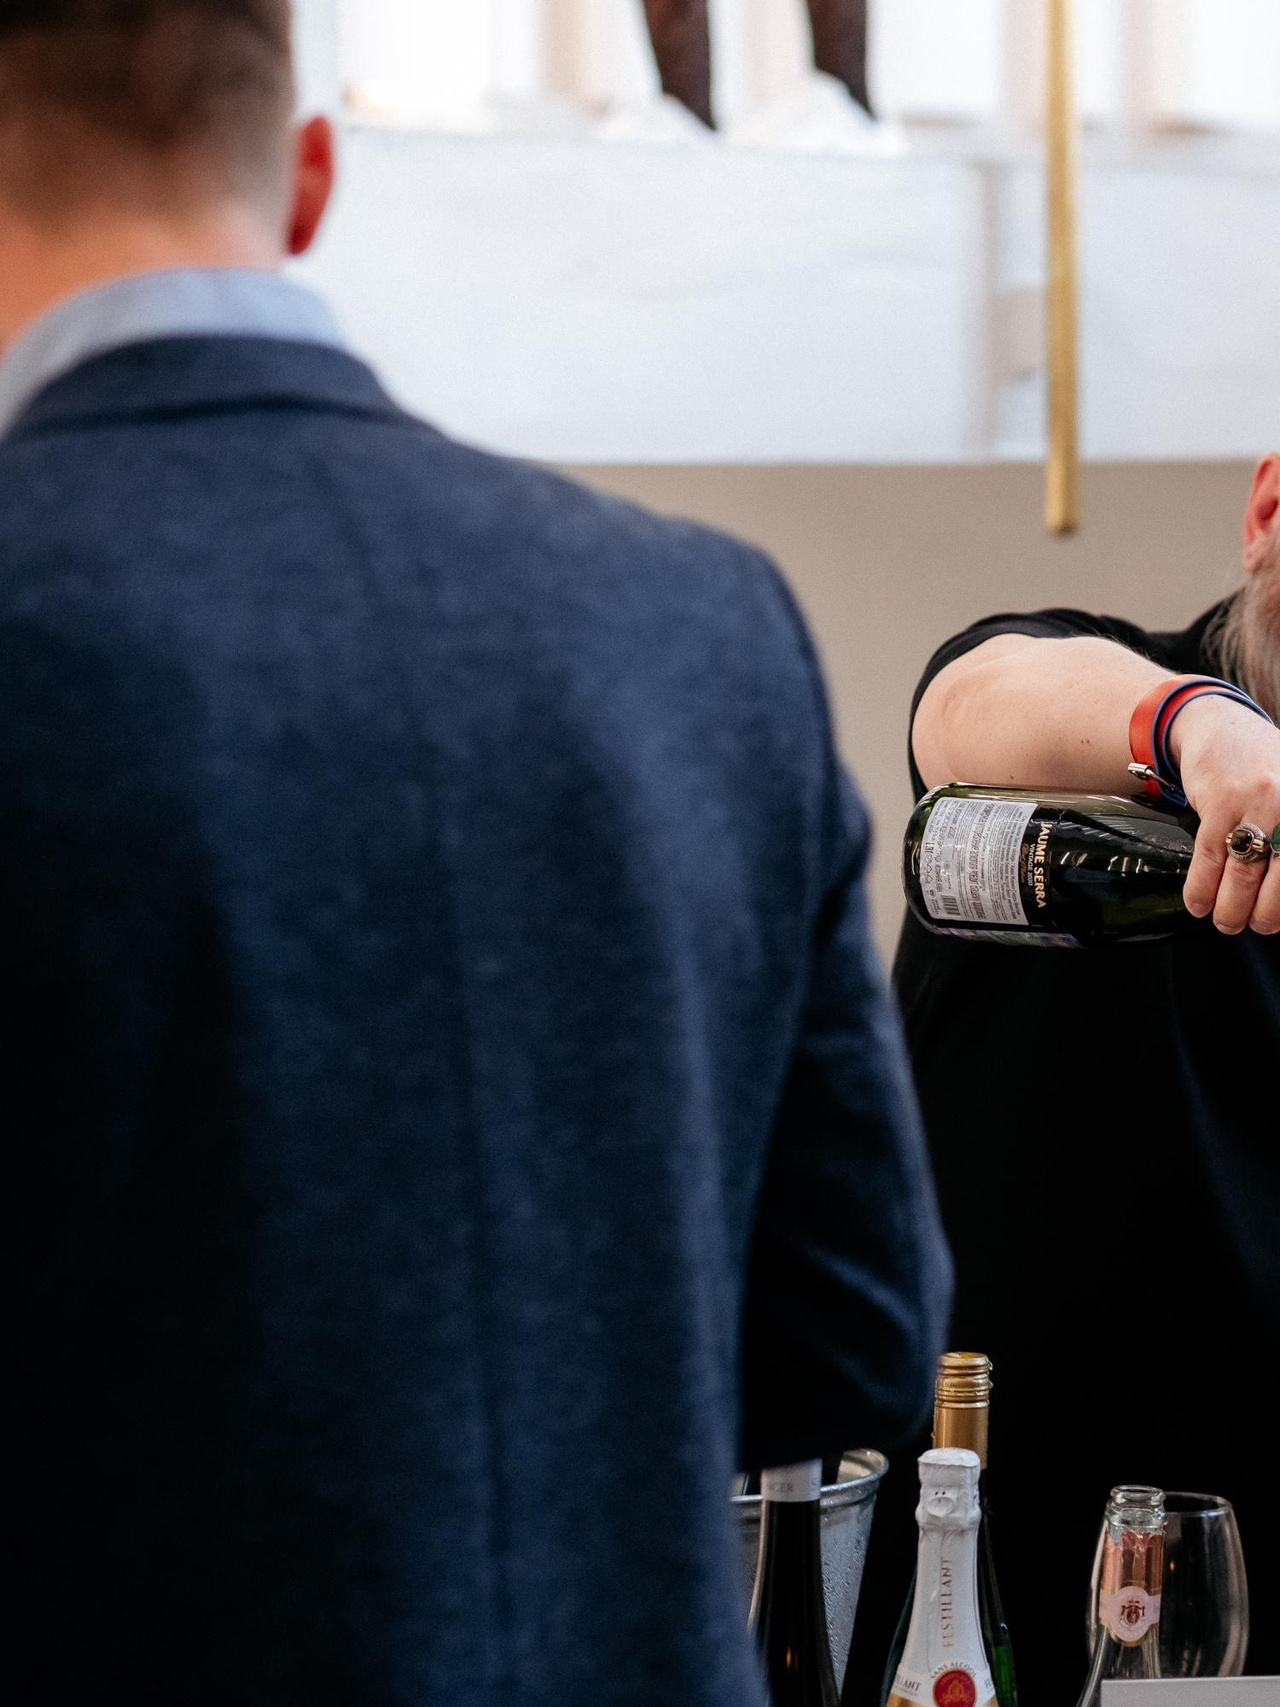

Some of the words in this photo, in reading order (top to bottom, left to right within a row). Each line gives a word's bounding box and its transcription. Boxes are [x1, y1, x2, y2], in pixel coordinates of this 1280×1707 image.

[1027, 844, 1035, 871] VINTAGE
[1034, 823, 1052, 863] JAUME
[1034, 867, 1047, 908] SERRA
[940, 1557, 954, 1648] FESTILLANT
